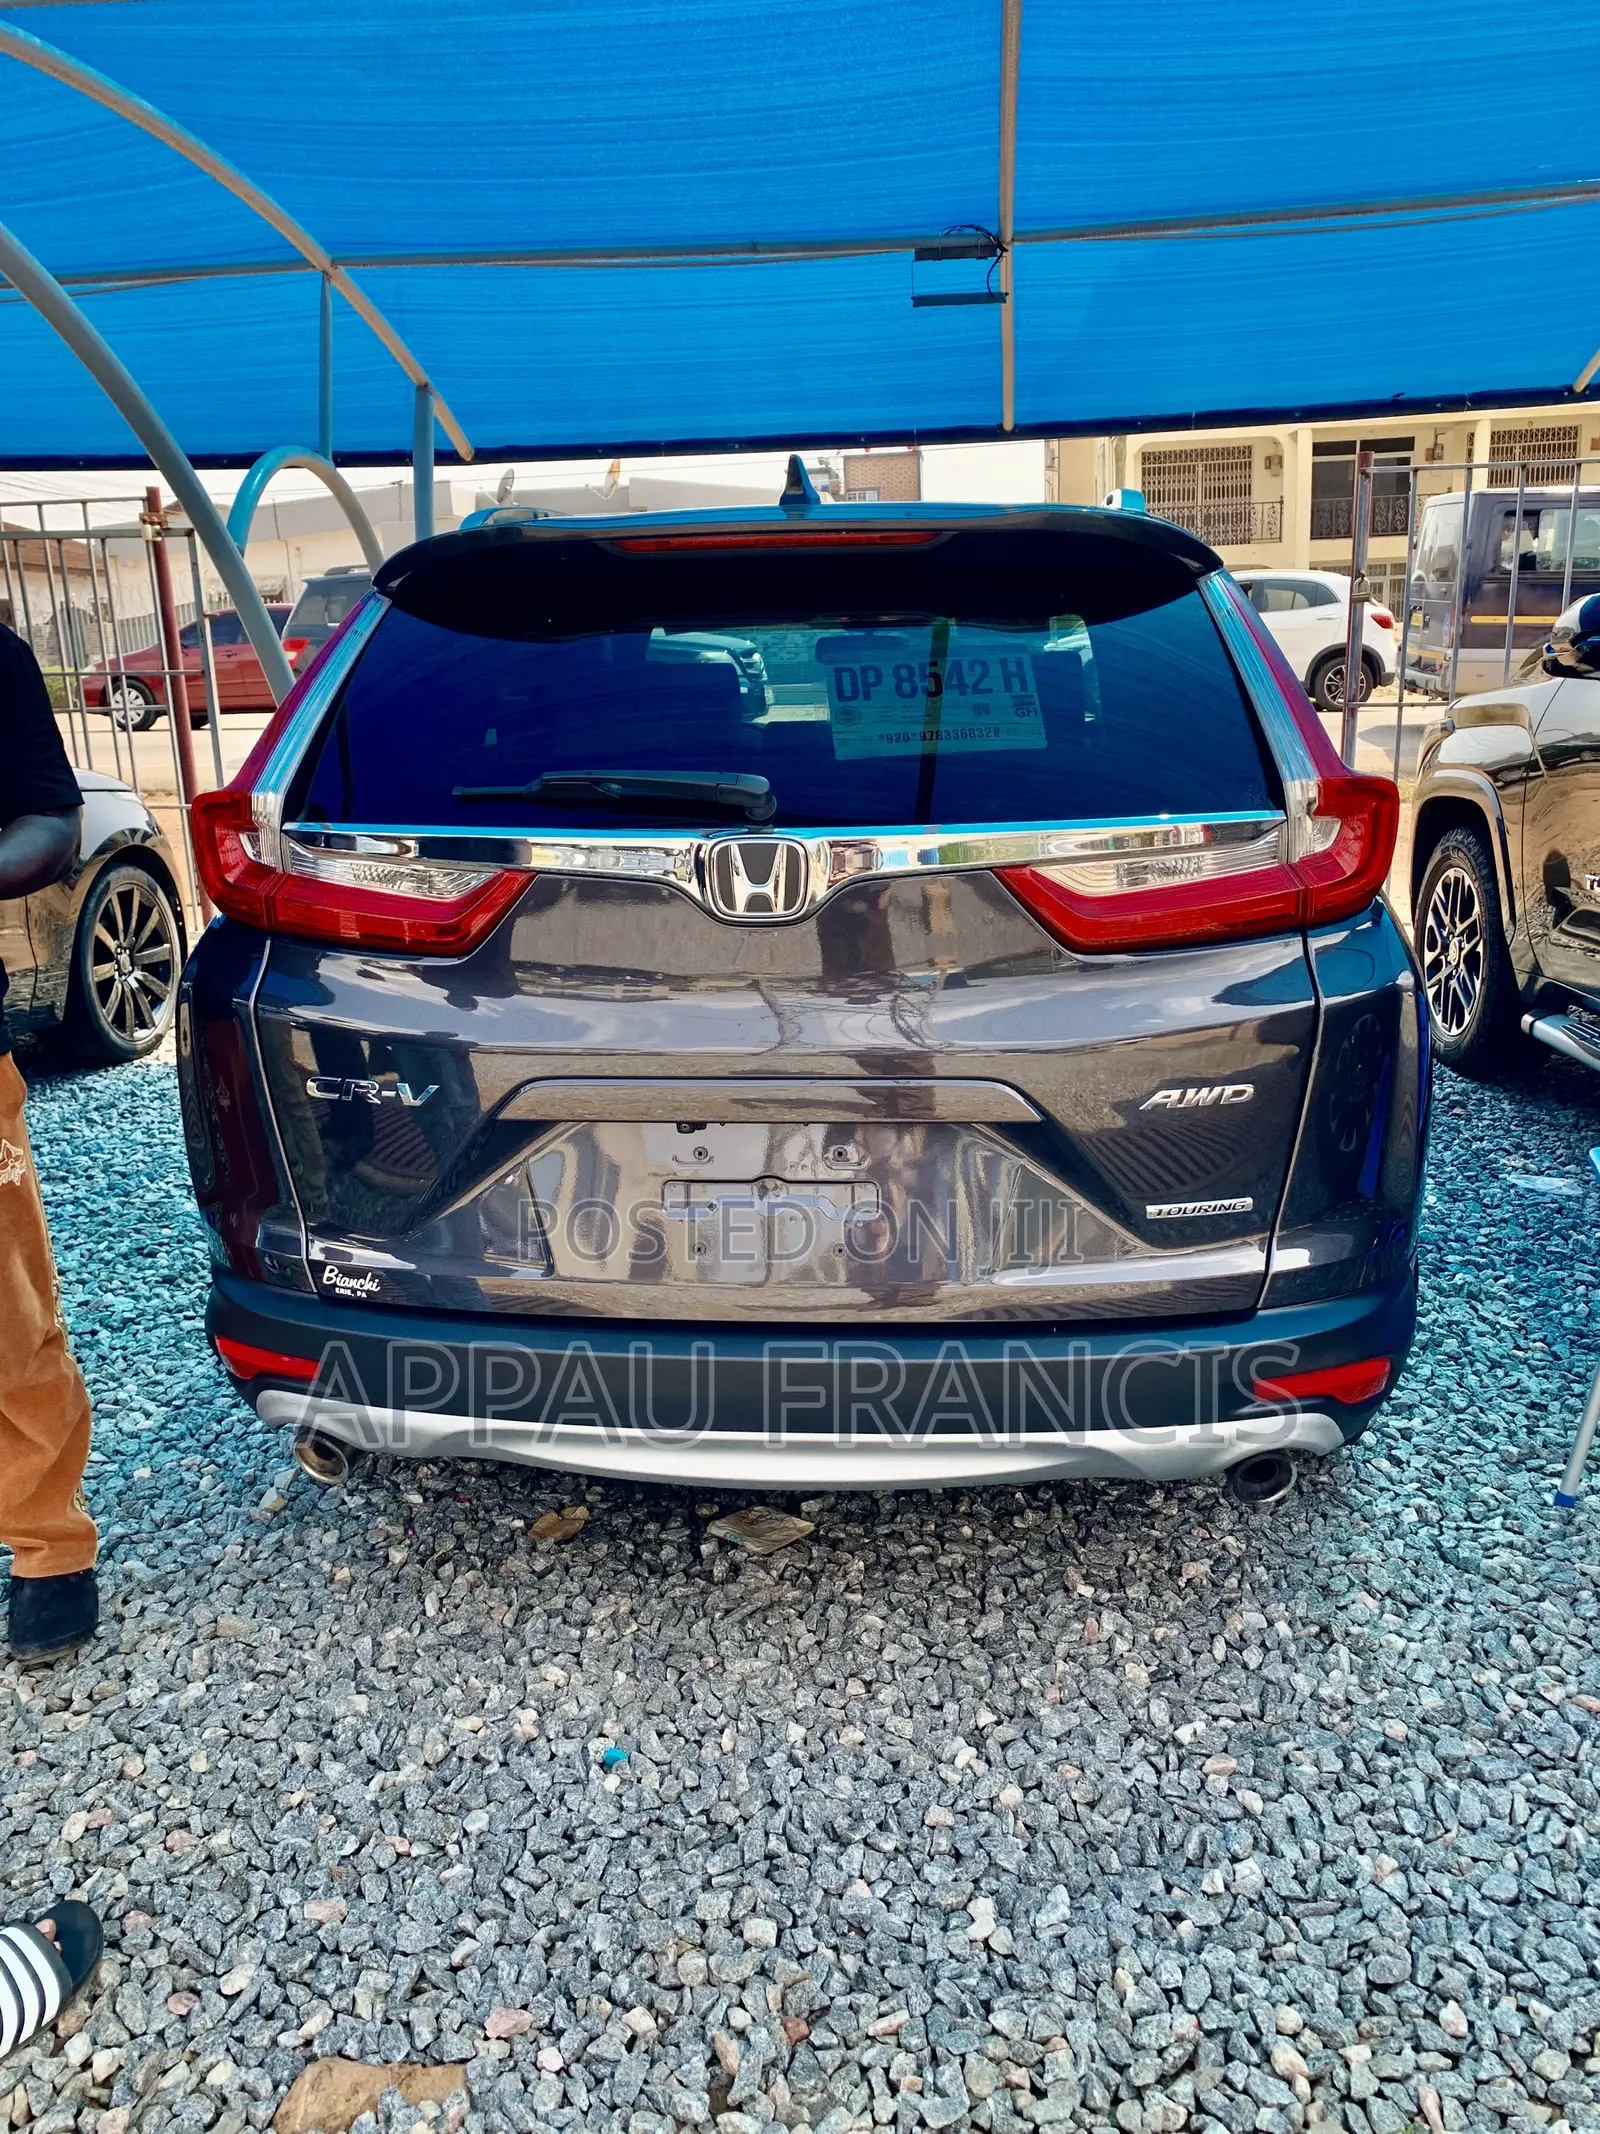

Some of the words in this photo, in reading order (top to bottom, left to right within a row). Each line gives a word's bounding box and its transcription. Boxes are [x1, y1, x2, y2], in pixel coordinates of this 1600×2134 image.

[834, 665, 883, 702] DP
[892, 659, 994, 699] 8542
[999, 657, 1029, 693] H
[1014, 706, 1038, 718] GH
[305, 1076, 440, 1106] CR-V
[1138, 1083, 1256, 1111] AWD
[1153, 1200, 1248, 1217] TOURING
[322, 1265, 381, 1292] Bianchi
[335, 1287, 355, 1297] ERIE,
[356, 1290, 368, 1298] PA
